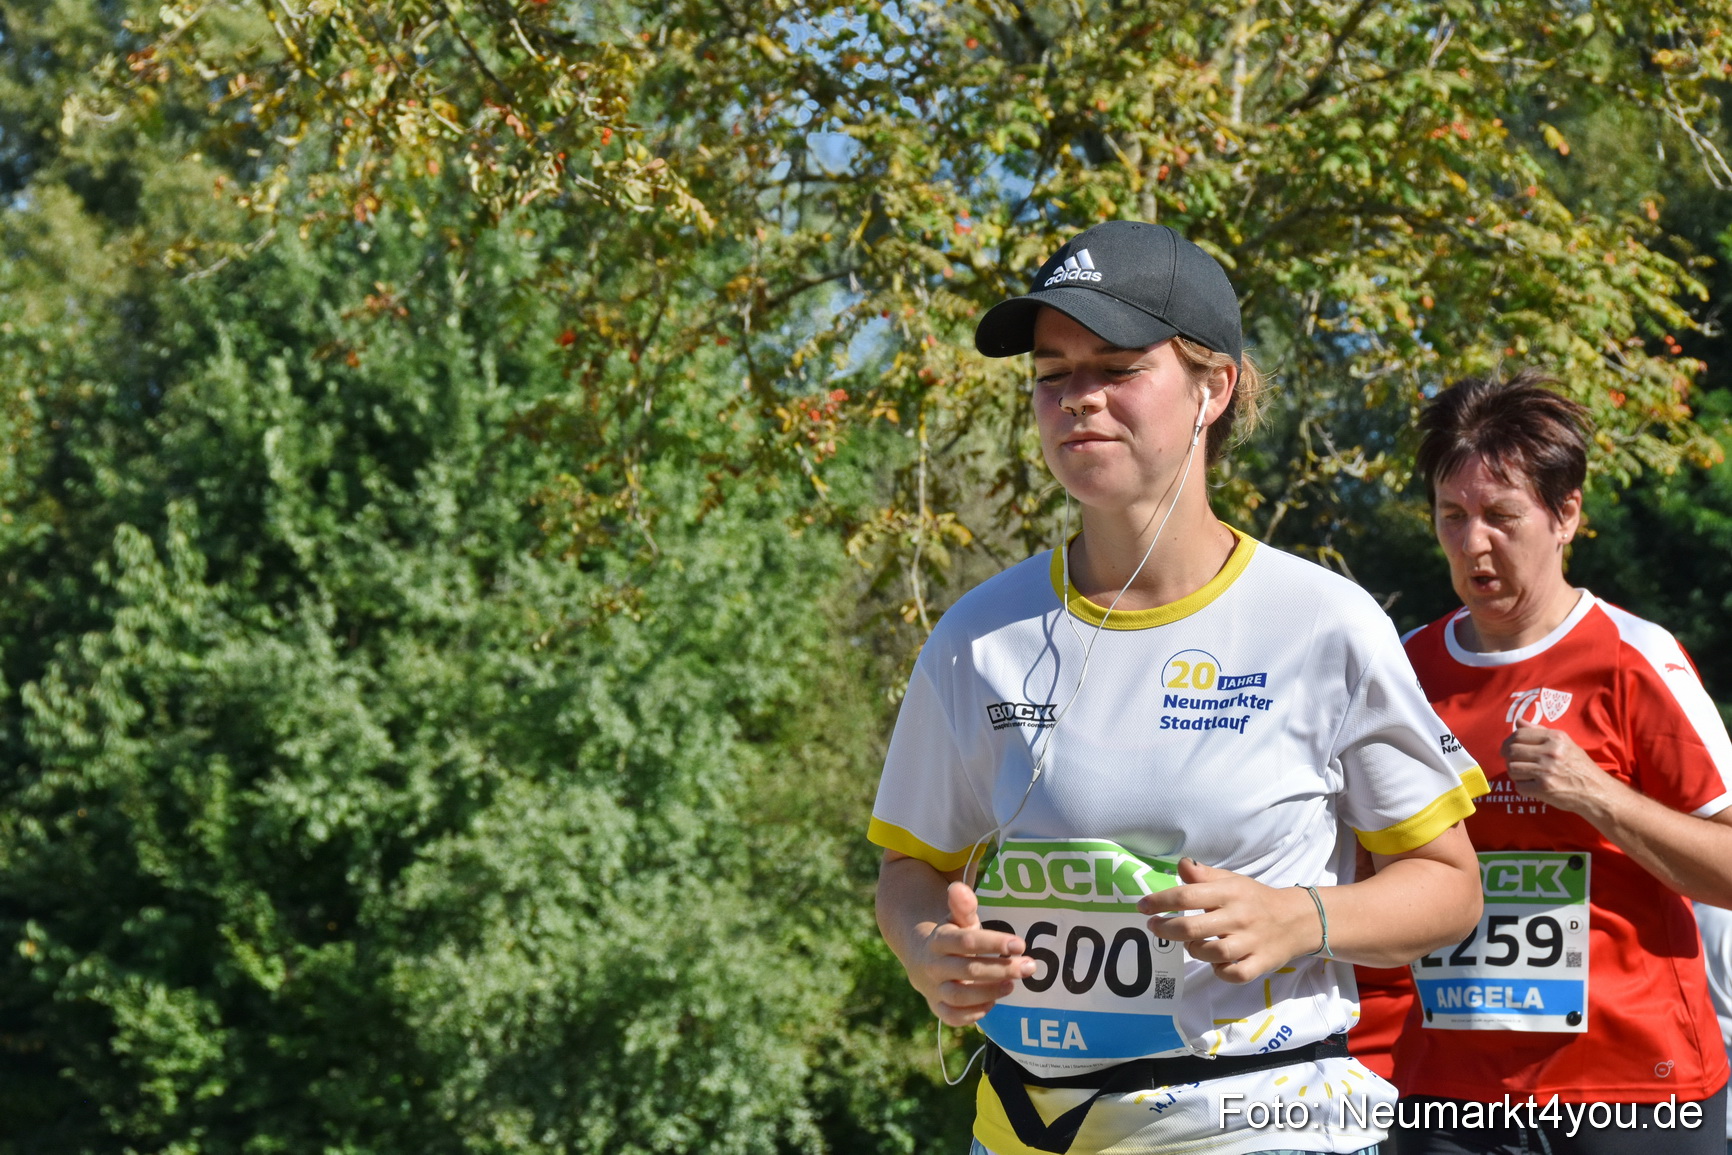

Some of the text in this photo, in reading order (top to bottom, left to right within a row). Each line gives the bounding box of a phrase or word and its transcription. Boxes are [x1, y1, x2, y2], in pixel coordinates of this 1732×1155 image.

[1044, 267, 1103, 287] adidas
[1167, 660, 1262, 690] 20 JAHRE
[986, 702, 1057, 724] BOCK
[1163, 693, 1274, 711] Neumarkter
[1159, 715, 1250, 734] Stadtlauf
[1436, 985, 1545, 1010] ANGELA
[1020, 1017, 1088, 1051] LEA
